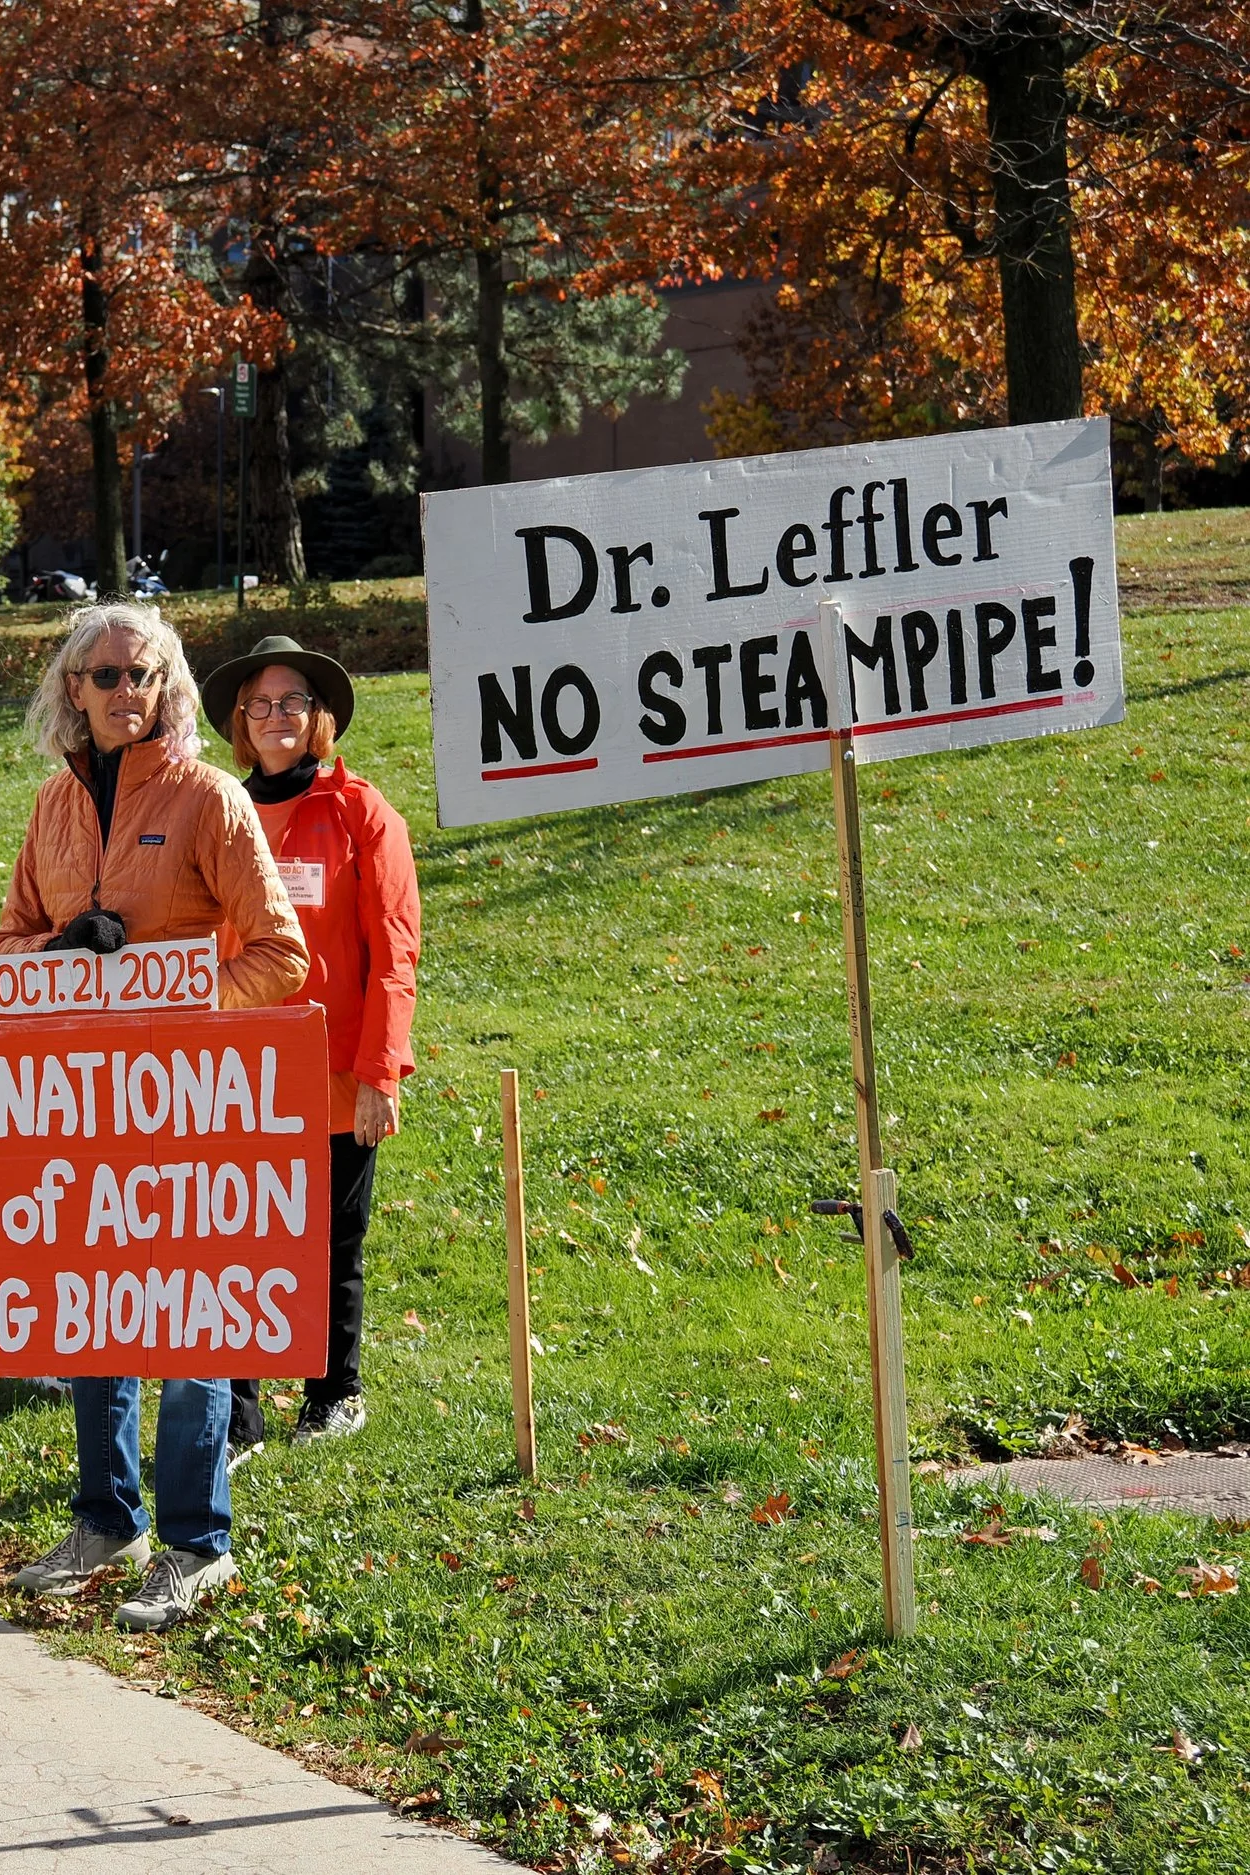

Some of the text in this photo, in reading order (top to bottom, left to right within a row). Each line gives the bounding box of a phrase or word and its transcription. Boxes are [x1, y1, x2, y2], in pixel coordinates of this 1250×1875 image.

[515, 477, 1009, 624] Dr. Leffler
[478, 556, 1095, 764] NO STEAMPIPE!
[292, 865, 305, 875] ACT
[72, 954, 111, 1008] 21,
[119, 948, 214, 1002] 2025
[2, 1158, 76, 1245] of
[85, 1158, 307, 1247] ACTION
[54, 1264, 298, 1354] BIOMASS
